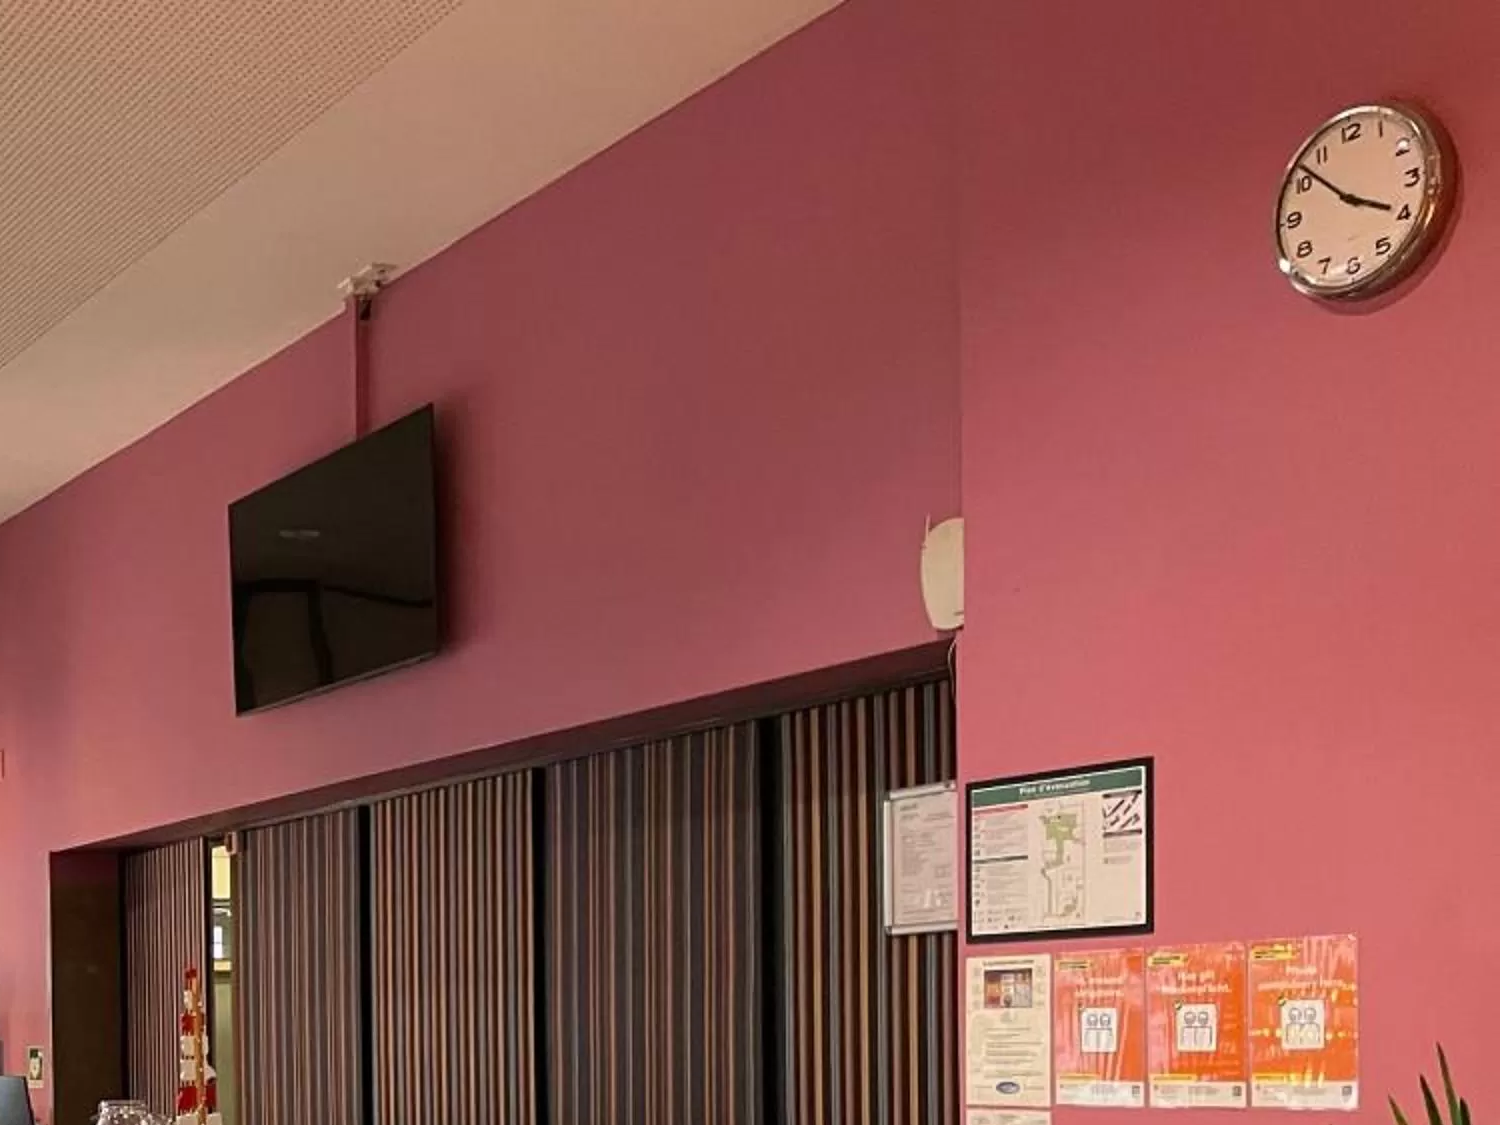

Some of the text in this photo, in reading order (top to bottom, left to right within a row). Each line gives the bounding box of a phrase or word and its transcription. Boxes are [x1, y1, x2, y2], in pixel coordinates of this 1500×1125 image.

[1340, 122, 1362, 144] 12
[1377, 119, 1384, 139] 1
[1315, 145, 1328, 165] 11
[1395, 137, 1411, 157] 2
[1295, 175, 1312, 195] 10
[1404, 167, 1421, 188] 3
[1286, 211, 1303, 229] 9
[1397, 203, 1412, 221] 4
[1296, 240, 1313, 258] 8
[1375, 237, 1392, 256] 5
[1318, 257, 1332, 275] 7
[1346, 256, 1362, 275] 6
